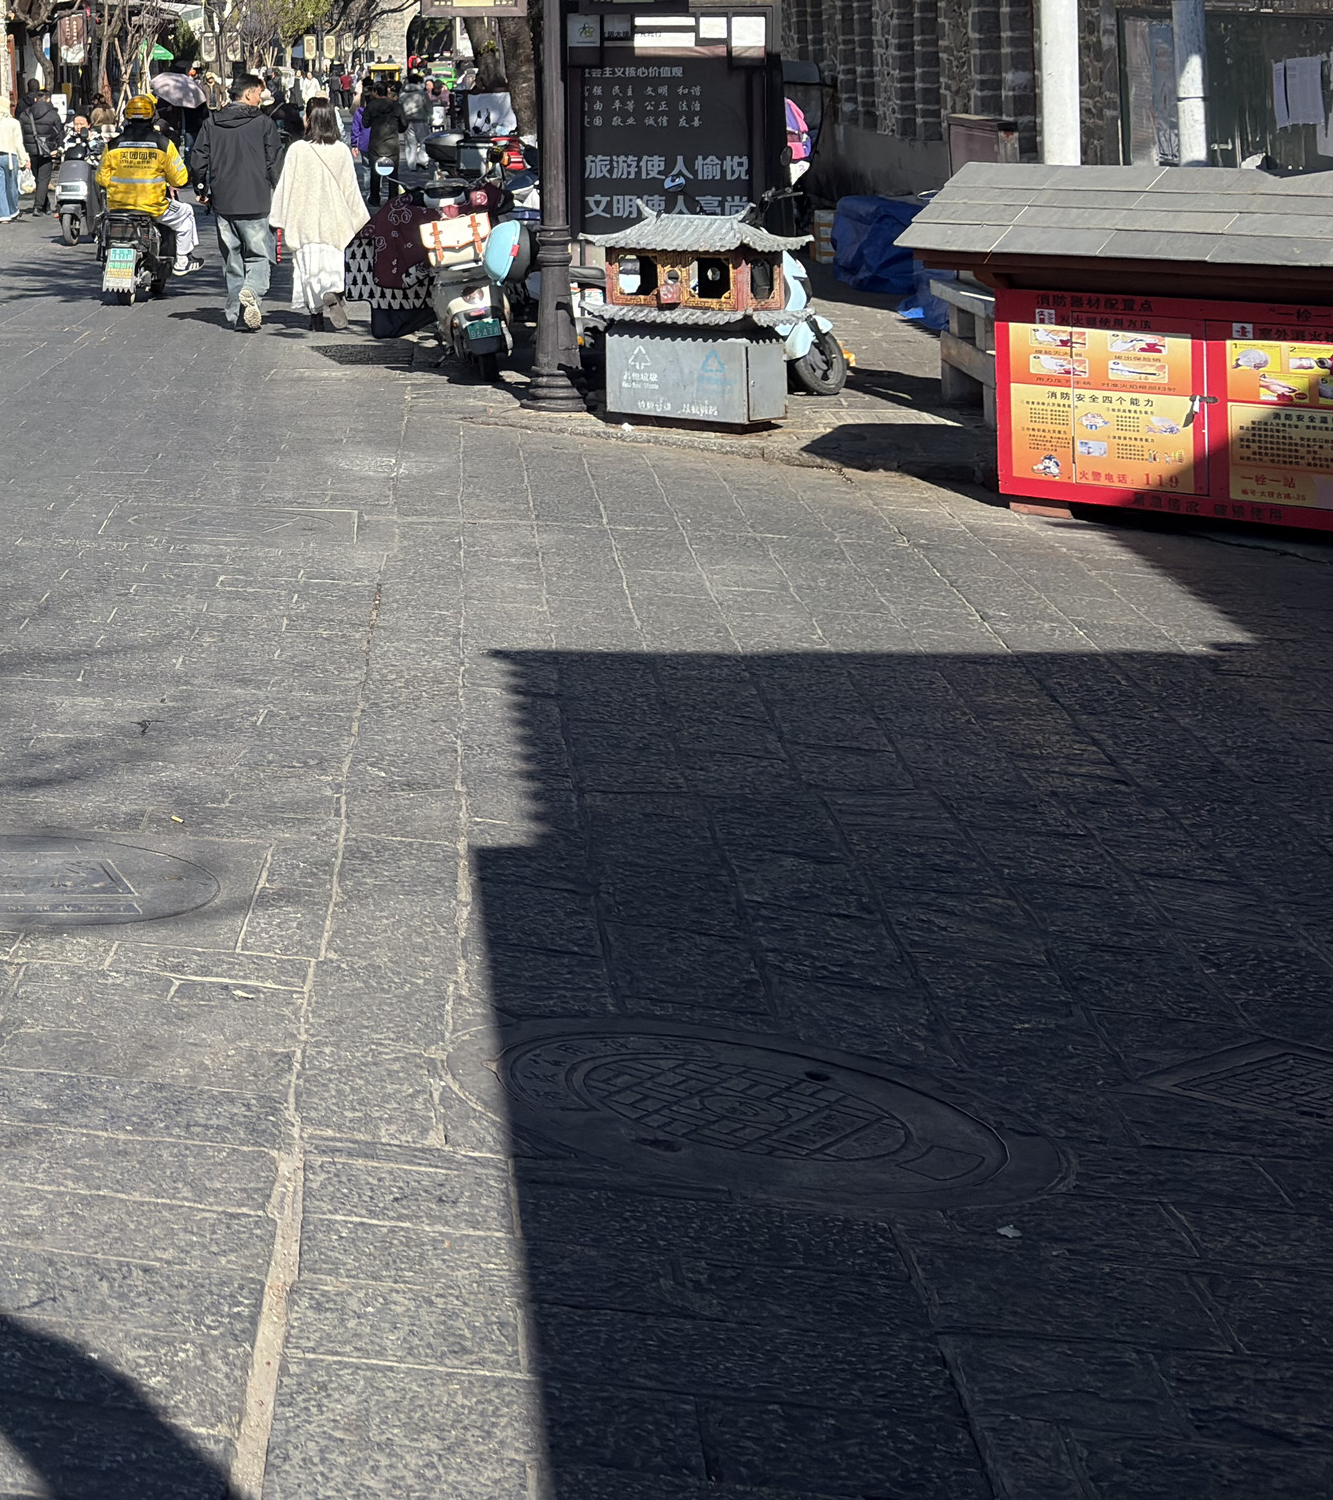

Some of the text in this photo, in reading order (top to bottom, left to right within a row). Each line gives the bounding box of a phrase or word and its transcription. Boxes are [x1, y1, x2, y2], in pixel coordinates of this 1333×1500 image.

[644, 85, 668, 96] 文明
[677, 85, 702, 96] 和谐
[612, 100, 635, 112] 平等
[644, 101, 669, 111] 公正
[678, 115, 702, 127] 友善
[585, 154, 749, 180] 旅游使人愉悦
[1047, 390, 1154, 408] 消防安全四个能力
